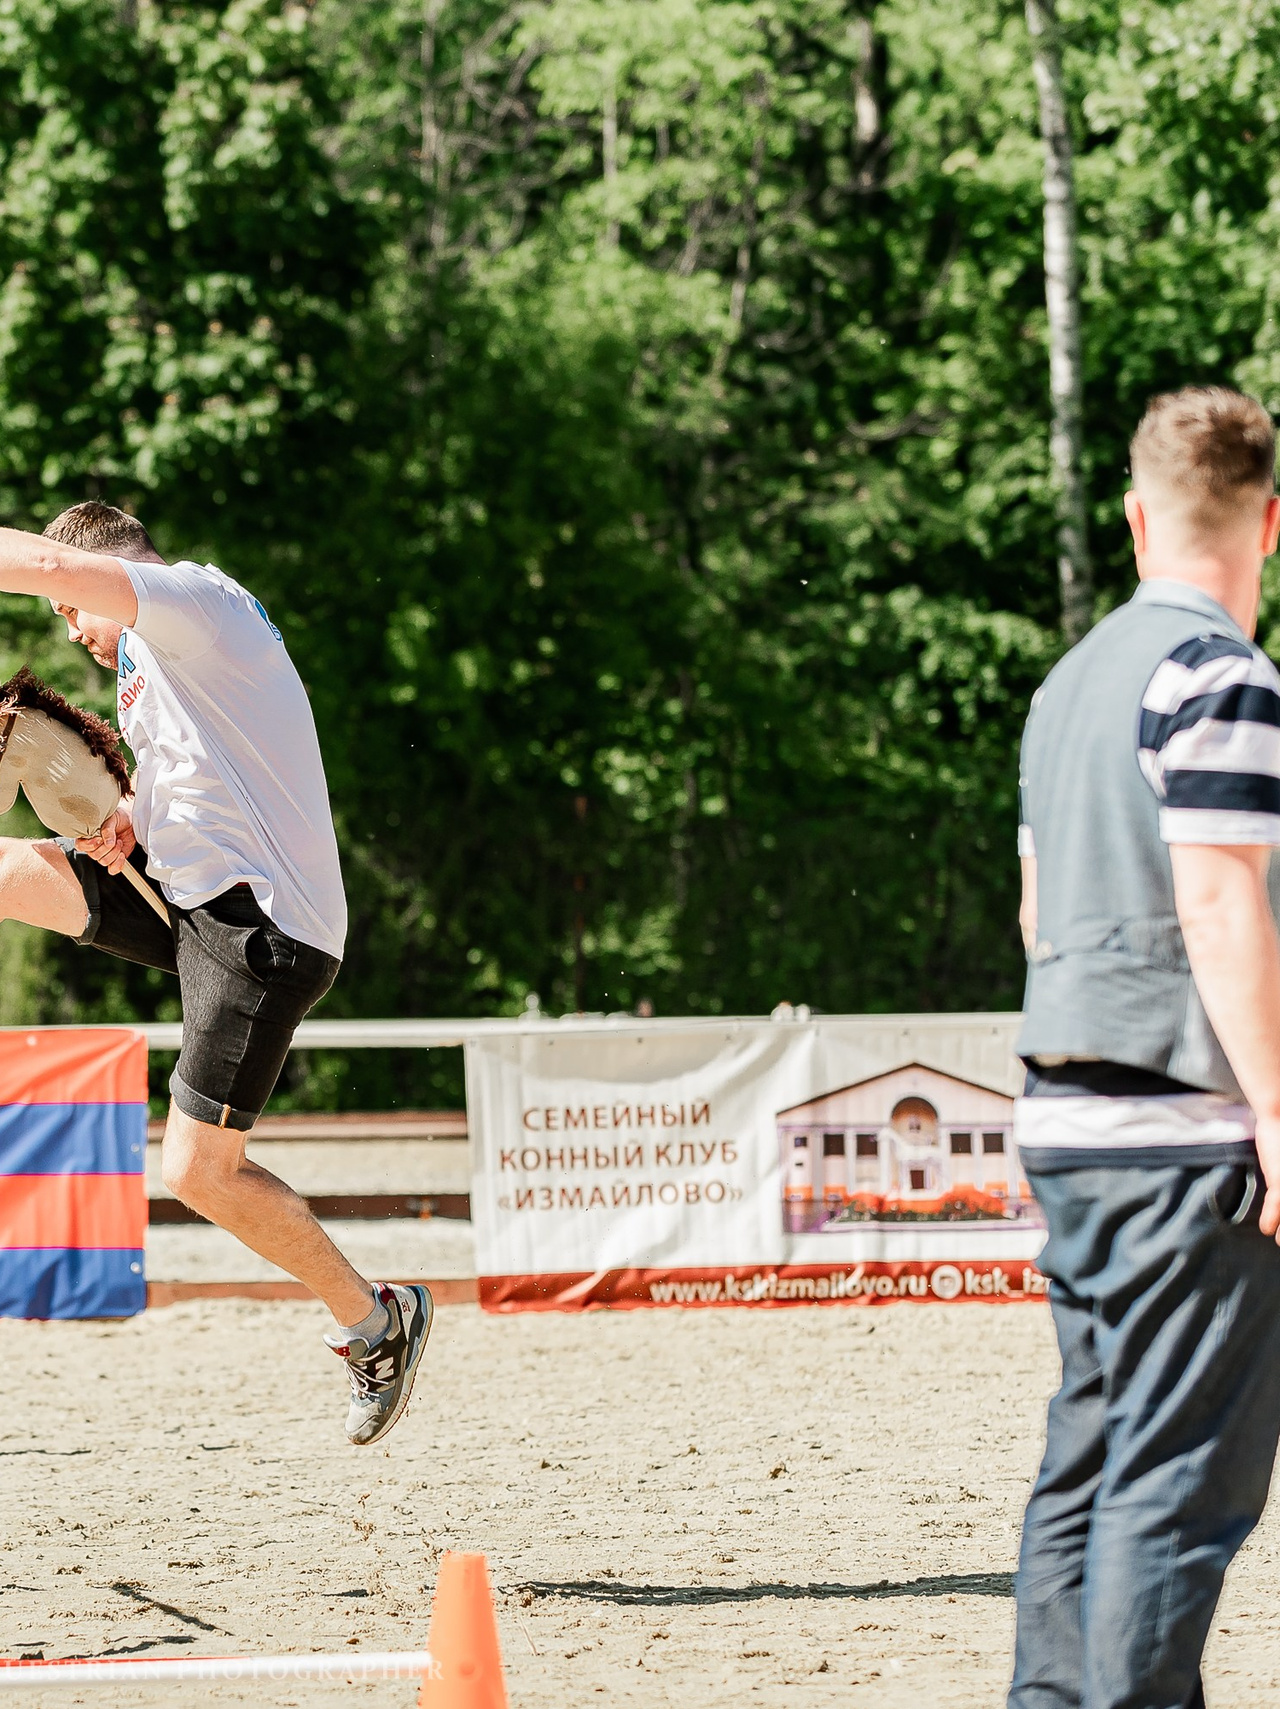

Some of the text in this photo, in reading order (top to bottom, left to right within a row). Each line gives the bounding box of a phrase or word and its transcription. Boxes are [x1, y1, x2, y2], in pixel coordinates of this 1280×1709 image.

[522, 1098, 711, 1131] СЕМЕЙНЫЙ
[499, 1138, 739, 1172] КОННЫЙ КЛУБ
[497, 1178, 744, 1210] «ИЗМАЙЛОВО»
[649, 1270, 928, 1303] www.kskizmailovo.ru
[375, 1356, 394, 1380] N
